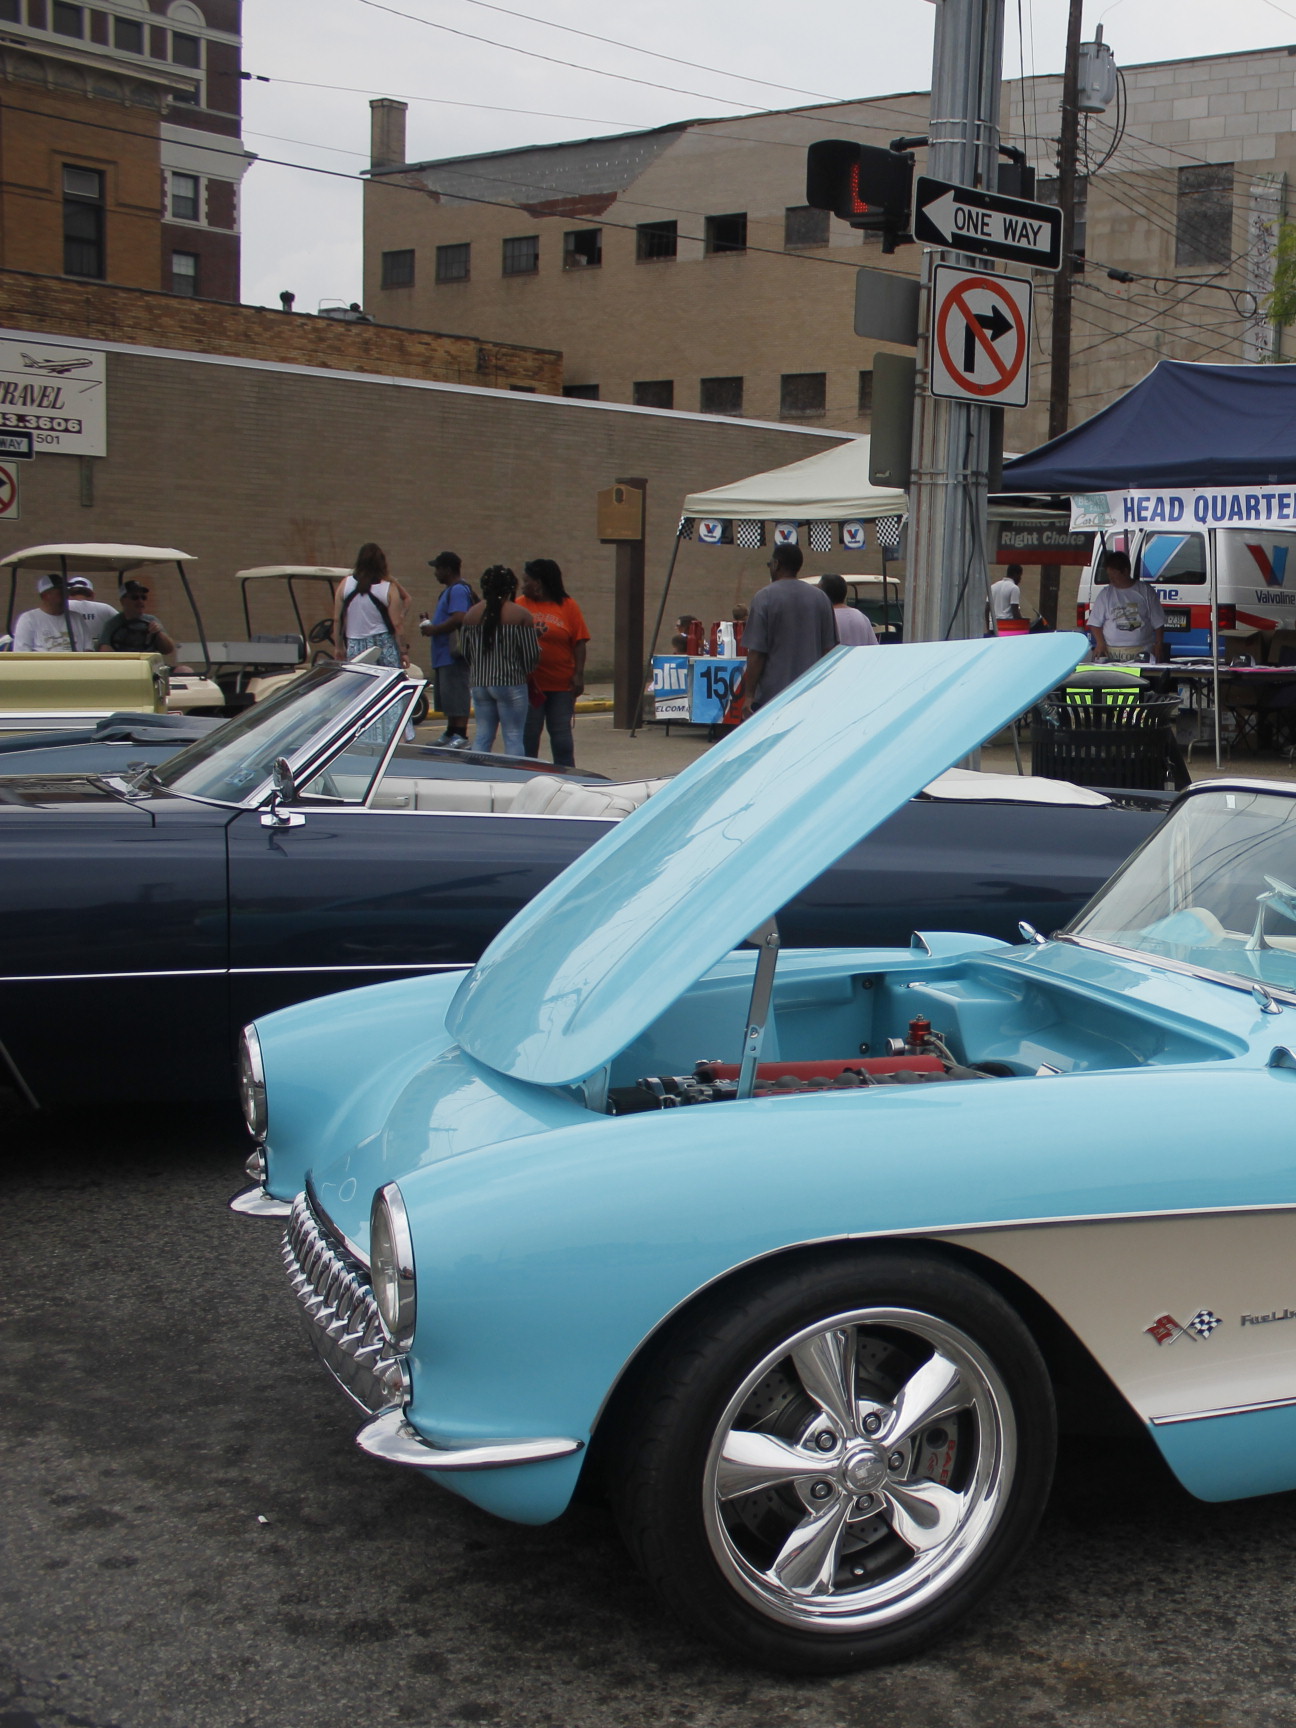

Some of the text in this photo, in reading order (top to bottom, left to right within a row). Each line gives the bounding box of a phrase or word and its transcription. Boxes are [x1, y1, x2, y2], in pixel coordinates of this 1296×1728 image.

[954, 207, 1042, 247] ONE WAY
[0, 413, 81, 432] 3.3606
[1123, 497, 1184, 523] HEAD
[1001, 531, 1085, 547] Right Choice
[1255, 590, 1296, 605] Valvoline
[1241, 1312, 1276, 1326] Fuel
